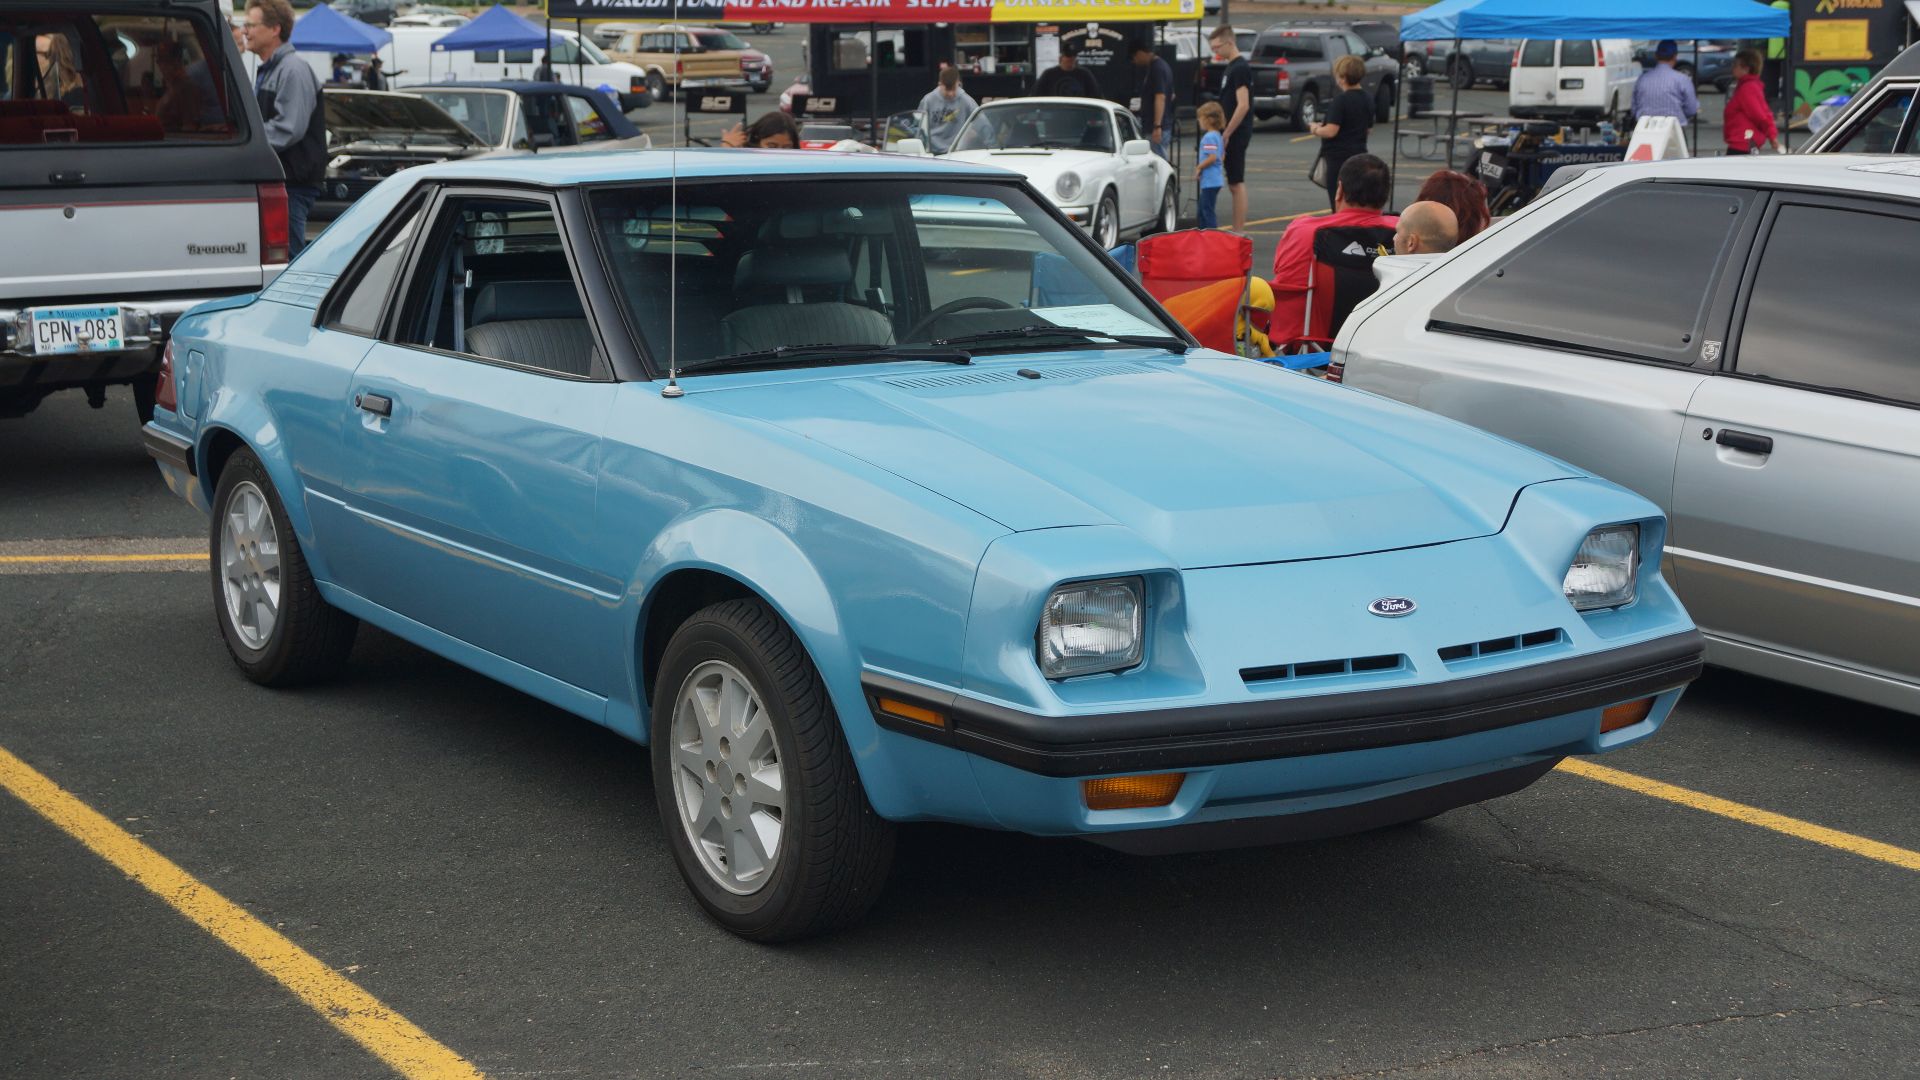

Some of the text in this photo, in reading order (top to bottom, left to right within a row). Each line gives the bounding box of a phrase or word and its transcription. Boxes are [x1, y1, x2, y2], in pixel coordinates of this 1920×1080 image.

[39, 318, 117, 343] CPN 083
[1382, 600, 1407, 610] Ford
